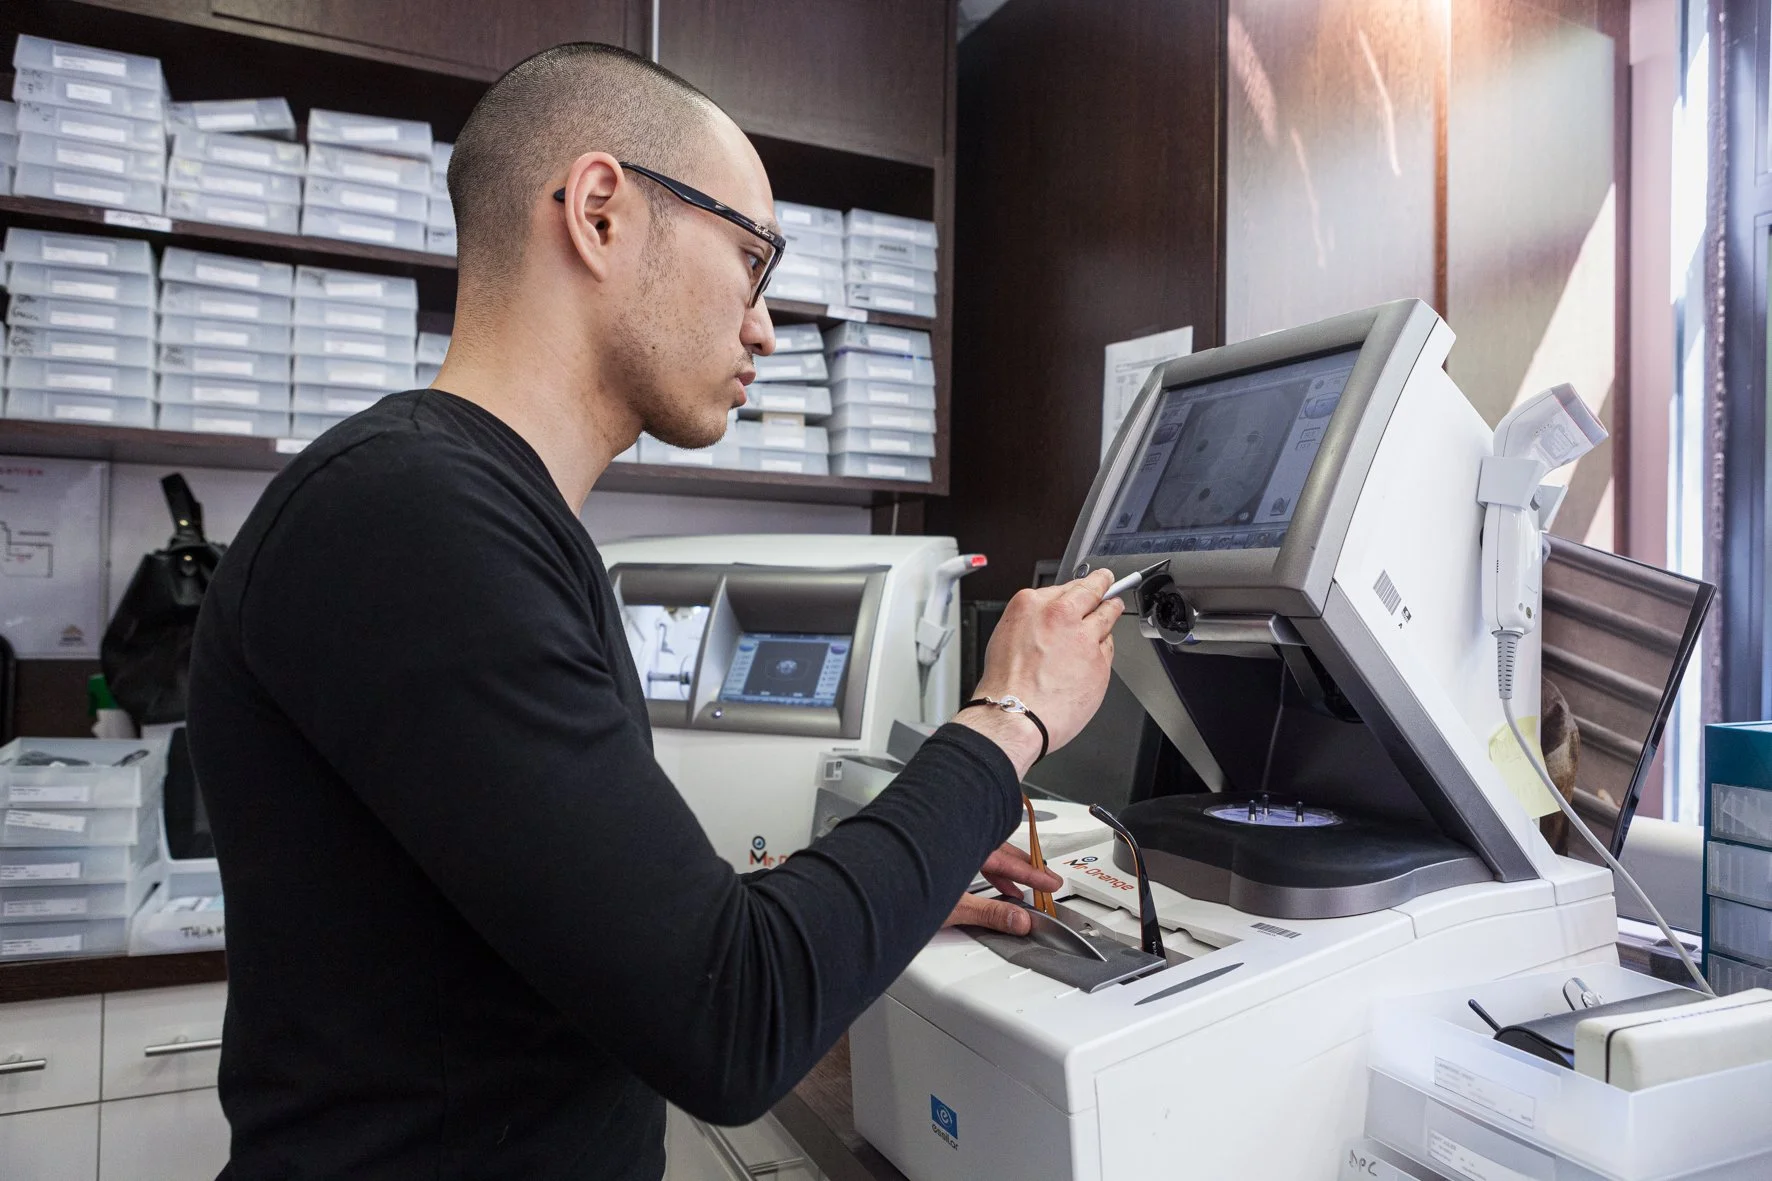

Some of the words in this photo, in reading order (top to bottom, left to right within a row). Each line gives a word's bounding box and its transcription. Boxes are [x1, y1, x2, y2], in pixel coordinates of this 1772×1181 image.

[749, 849, 775, 867] Mr
[1062, 859, 1088, 870] Mr
[1085, 868, 1135, 891] Orange
[931, 1123, 959, 1151] essilor
